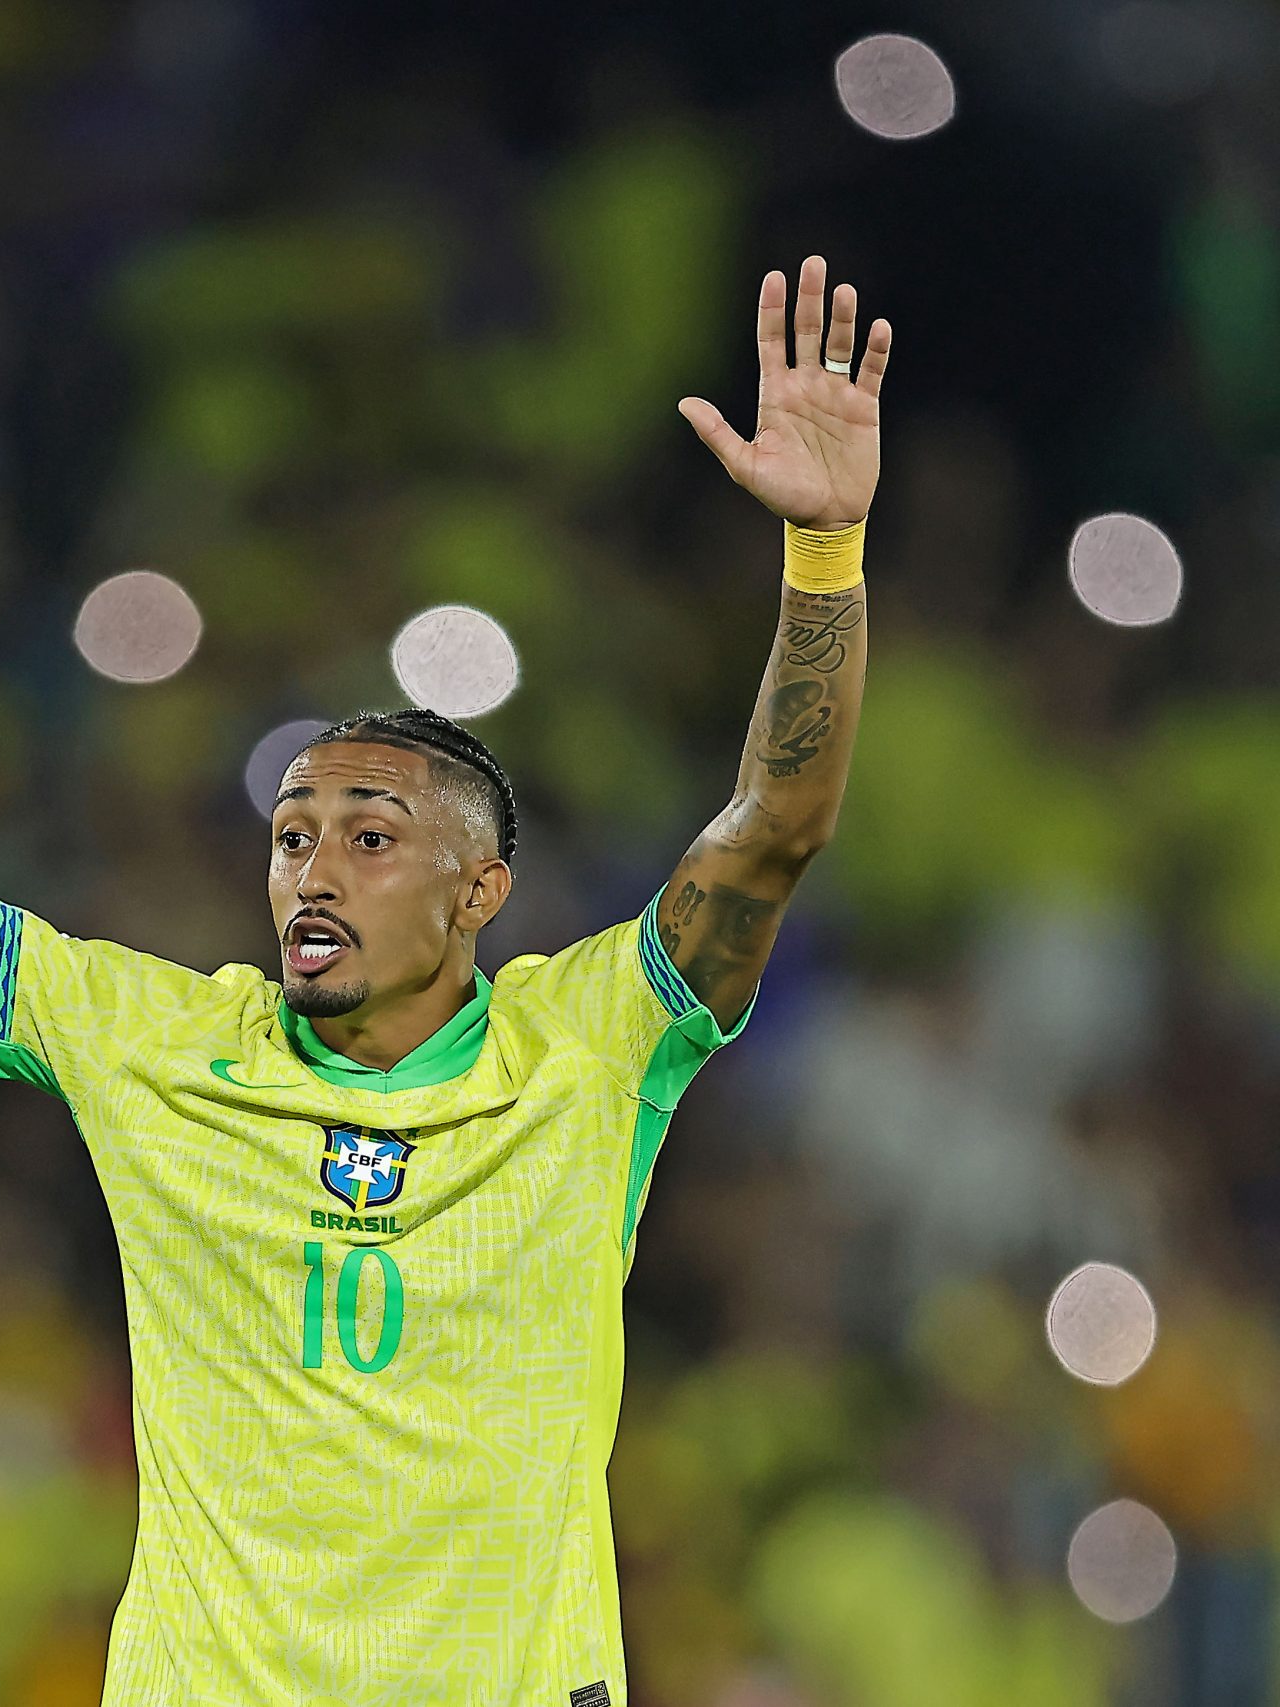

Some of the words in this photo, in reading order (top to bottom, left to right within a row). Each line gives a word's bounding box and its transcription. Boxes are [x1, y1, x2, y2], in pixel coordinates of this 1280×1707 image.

[347, 1152, 383, 1168] CBF
[310, 1209, 404, 1234] BRASIL
[303, 1241, 404, 1374] 10
